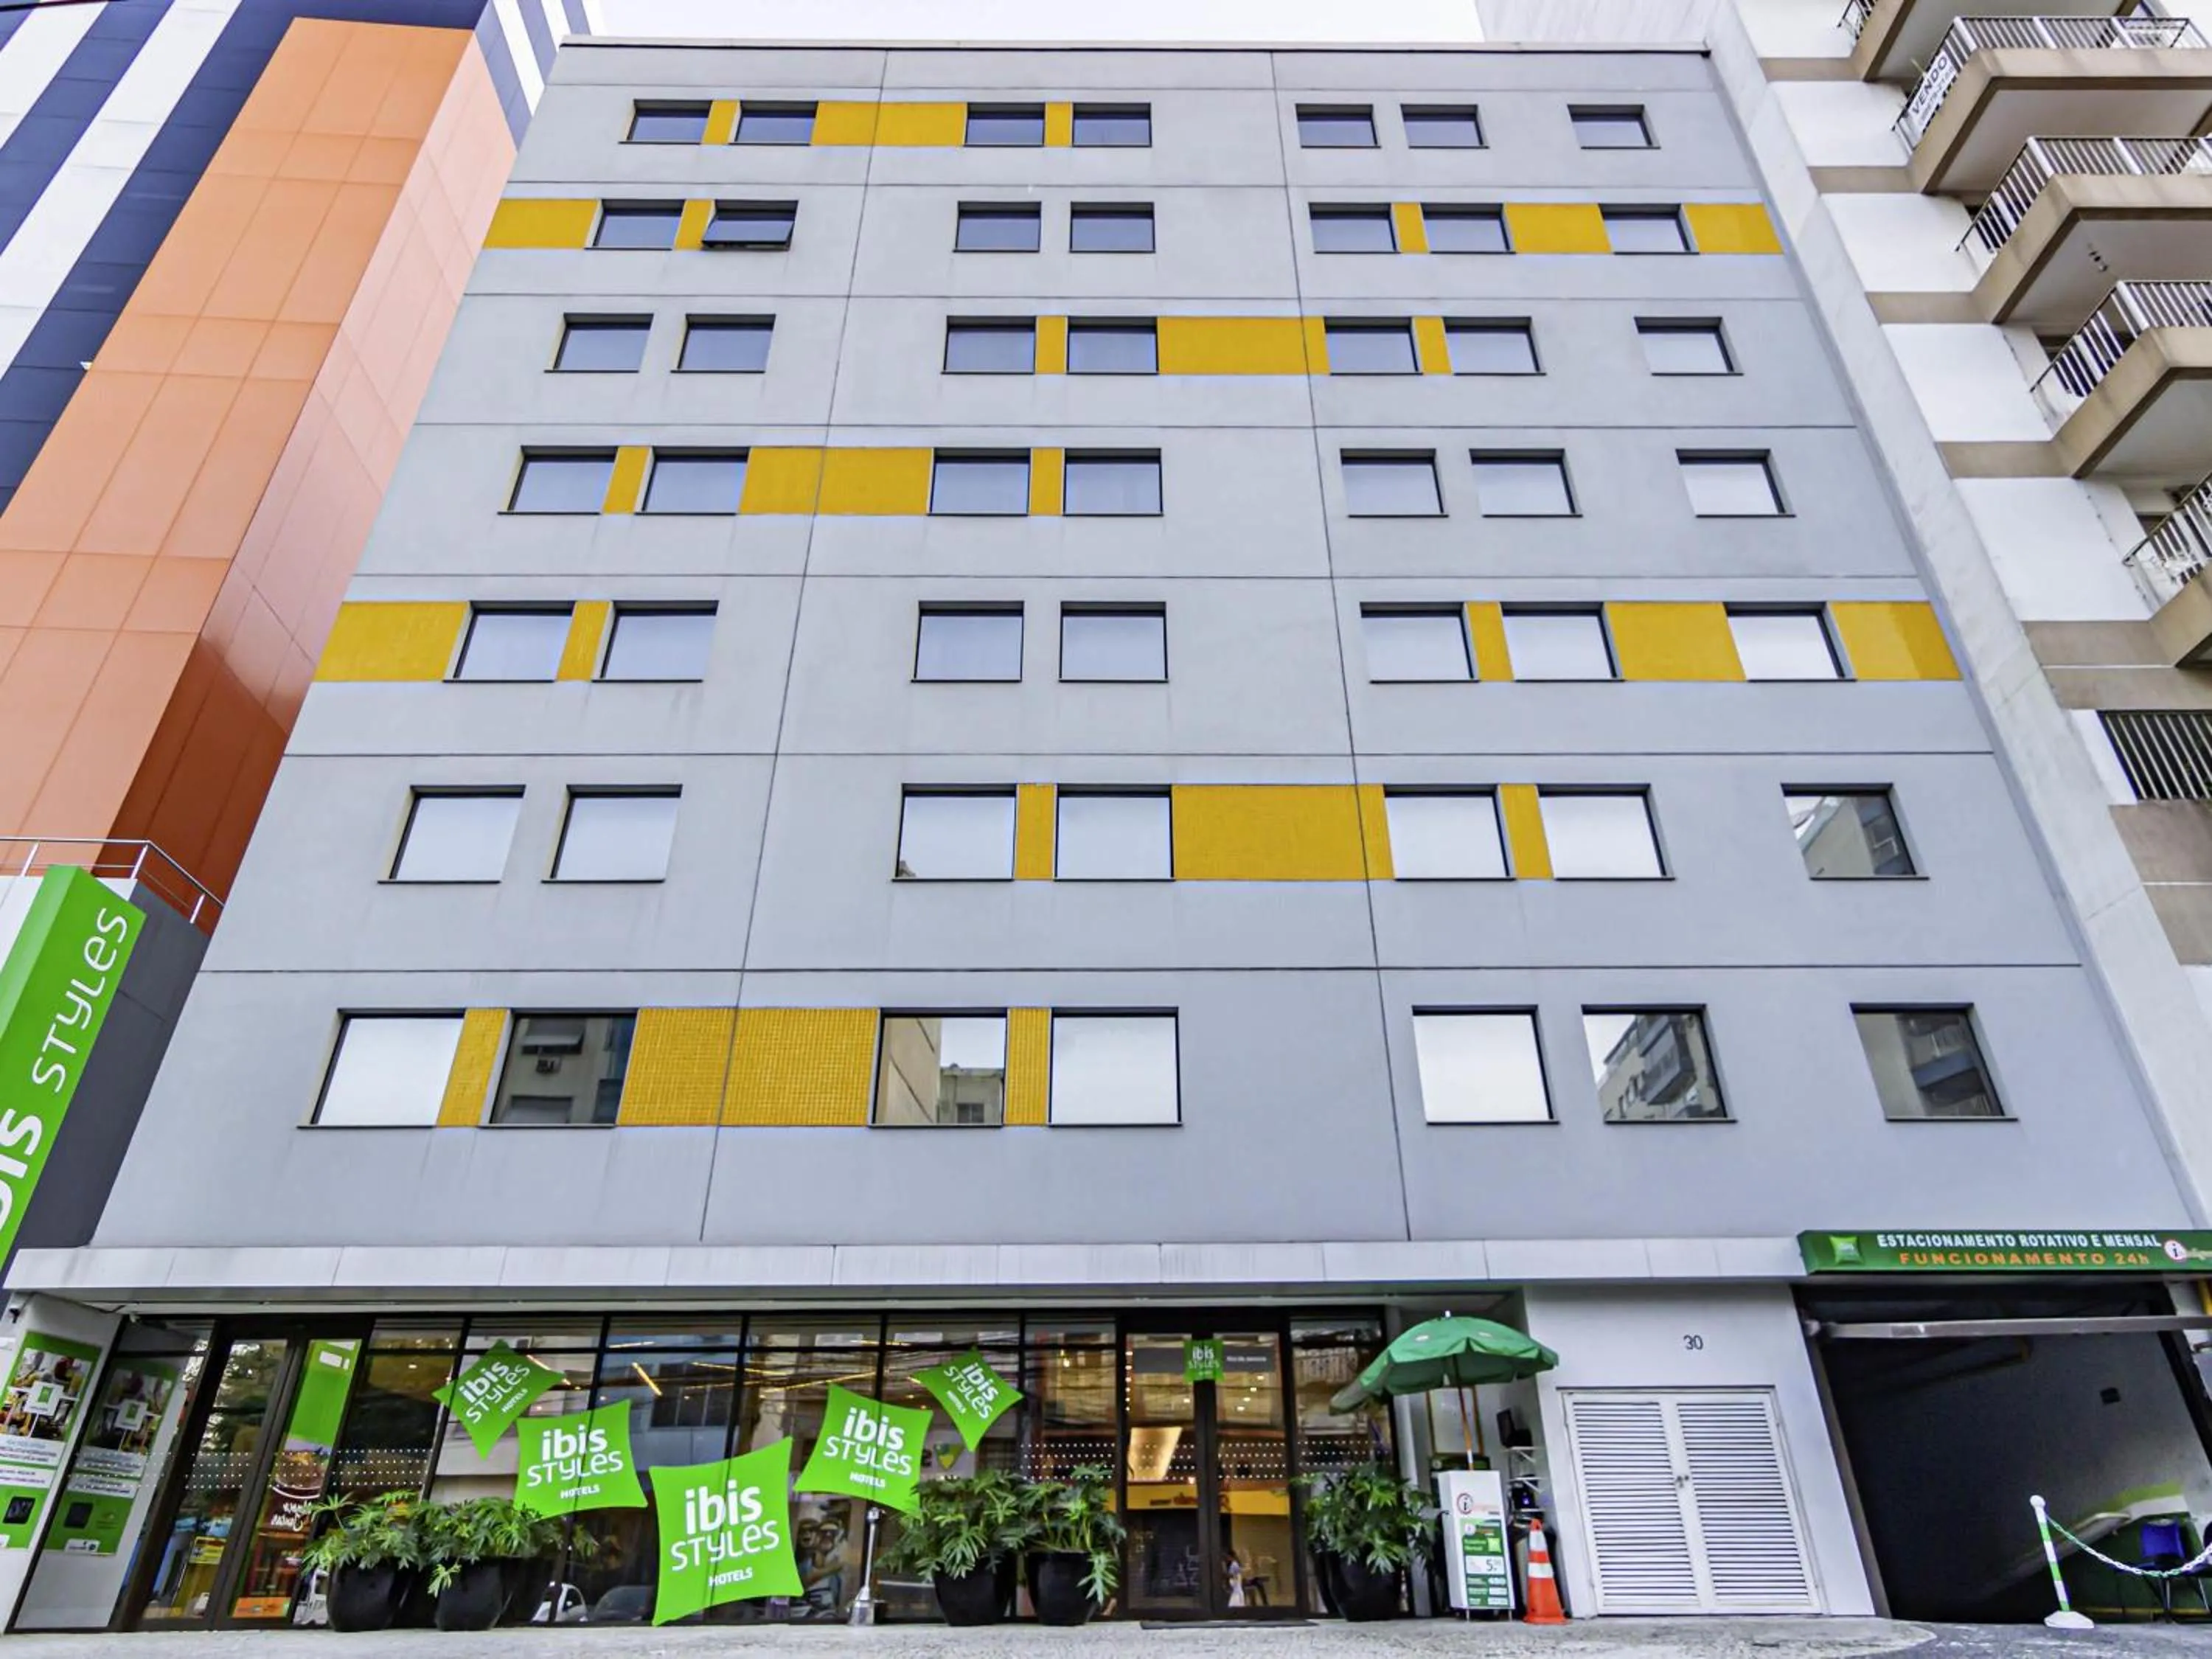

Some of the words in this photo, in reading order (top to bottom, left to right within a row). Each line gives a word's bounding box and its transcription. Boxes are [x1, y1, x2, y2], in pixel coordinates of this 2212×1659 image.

[1912, 56, 1947, 114] VENDO
[1877, 1234, 2016, 1248] ESTACIONAMENTO
[2018, 1234, 2088, 1247] ROTATIVO
[2090, 1234, 2101, 1247] E
[2104, 1234, 2162, 1247] MENSAL
[1899, 1252, 2106, 1265] FUNCIONAMENTO
[1683, 1334, 1703, 1351] 30
[459, 1362, 509, 1403] ibis
[961, 1362, 998, 1401] ibis
[542, 1424, 608, 1461] ibis
[843, 1407, 905, 1450] ibis
[560, 1484, 599, 1499] HOTELS
[685, 1479, 762, 1535] ibis
[709, 1567, 753, 1586] HOTELS
